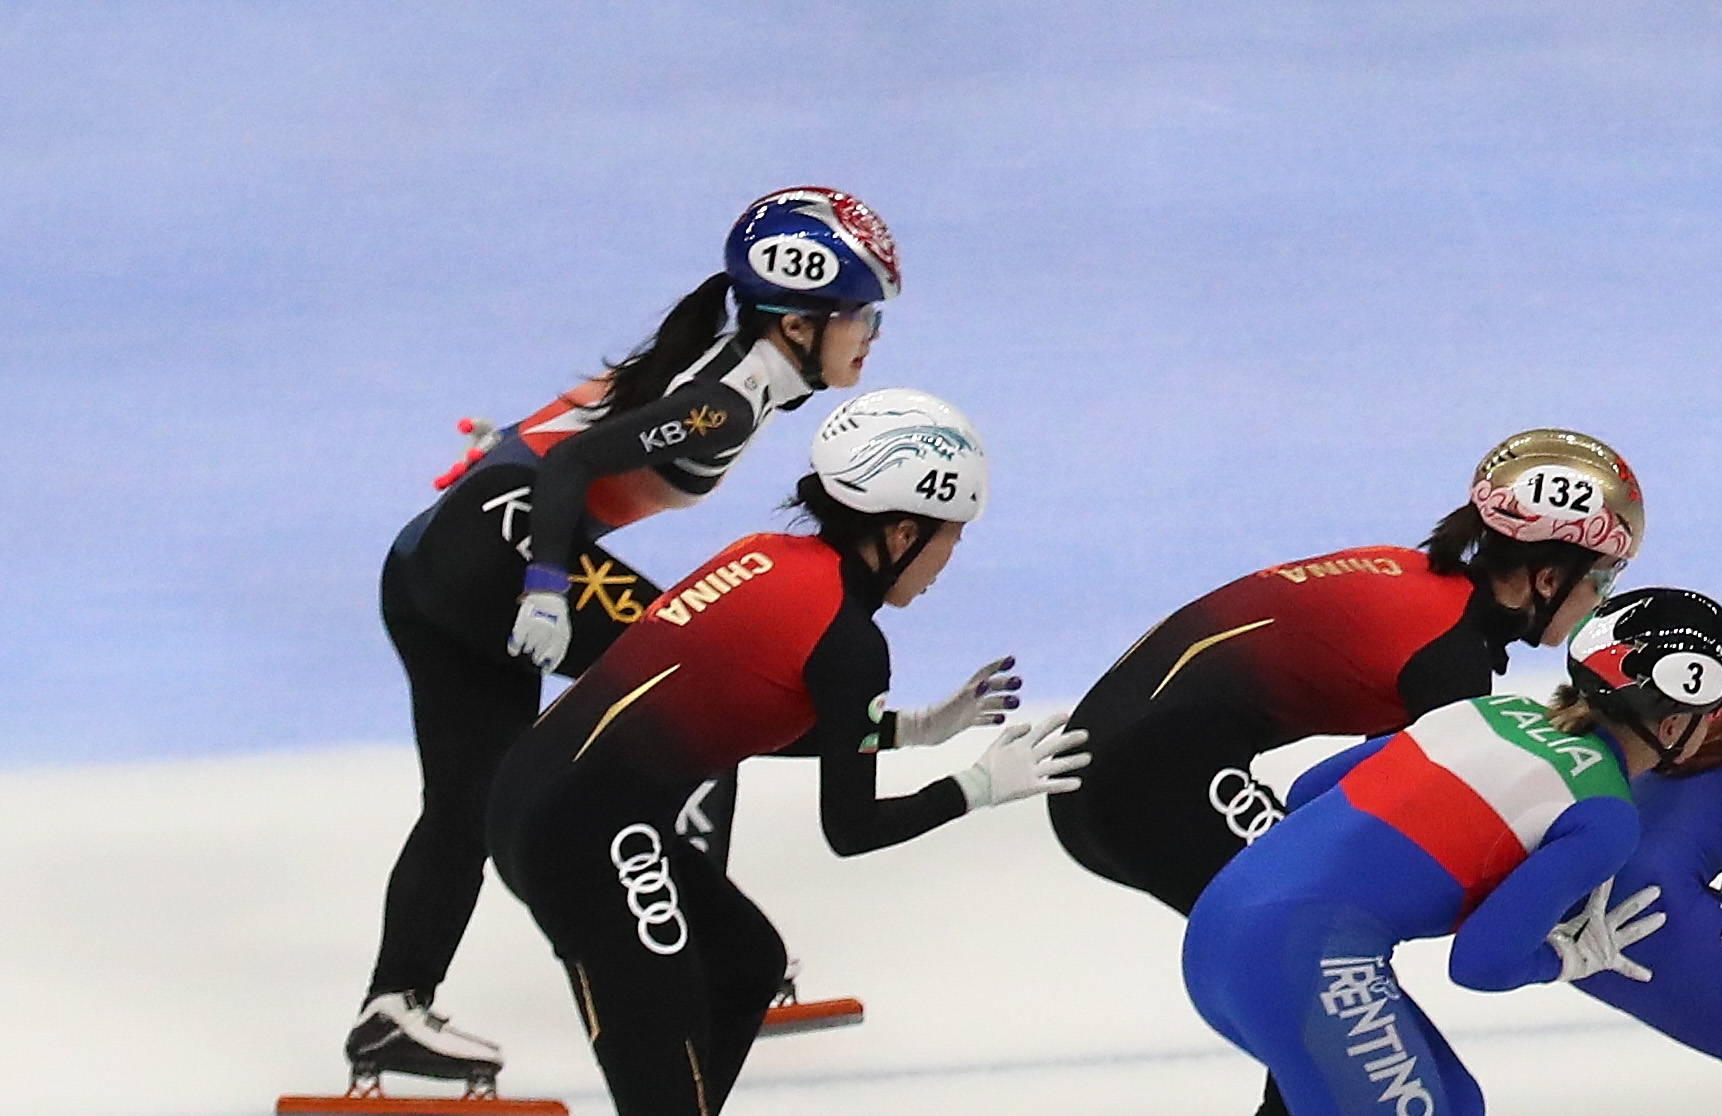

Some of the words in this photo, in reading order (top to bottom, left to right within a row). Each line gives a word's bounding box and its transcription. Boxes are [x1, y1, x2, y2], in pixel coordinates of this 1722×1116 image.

[762, 243, 826, 281] 138
[915, 469, 958, 502] 45
[1528, 473, 1593, 514] 132
[1278, 558, 1403, 583] CHINA
[656, 551, 774, 627] CHINA
[1683, 662, 1703, 694] 3
